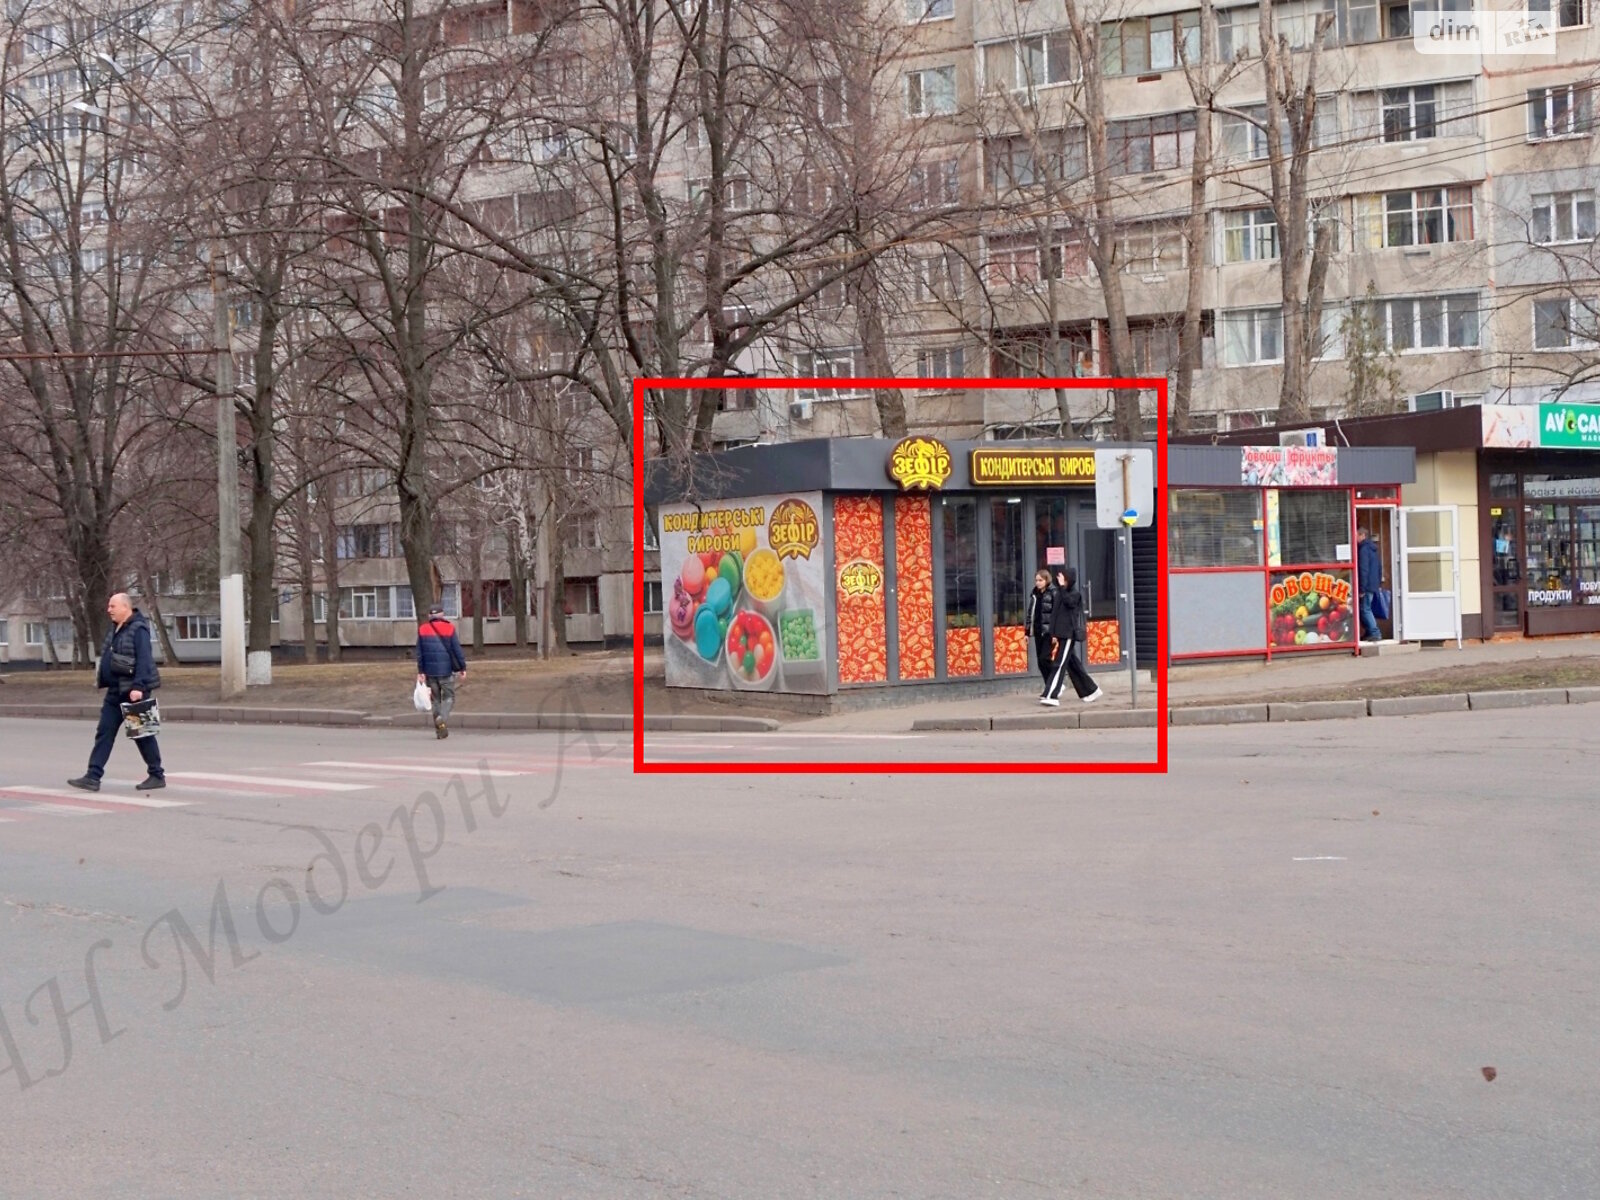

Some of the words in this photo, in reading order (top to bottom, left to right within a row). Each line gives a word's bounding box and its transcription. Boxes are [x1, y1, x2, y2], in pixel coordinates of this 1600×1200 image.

[1545, 409, 1600, 434] AVOCA
[1581, 434, 1600, 442] MAR
[895, 456, 949, 475] ЗЕФІР
[980, 456, 1055, 480] КОНДИТЕРСЬКІ
[663, 506, 765, 533] КОНДИТЕРСЬКІ
[772, 522, 815, 543] ЗЕФІР
[687, 533, 741, 554] ВИРОБИ
[843, 573, 878, 587] ЗЕФІР
[1270, 572, 1351, 605] ОВОЩИ
[1528, 589, 1572, 602] ПРОДУКТИ
